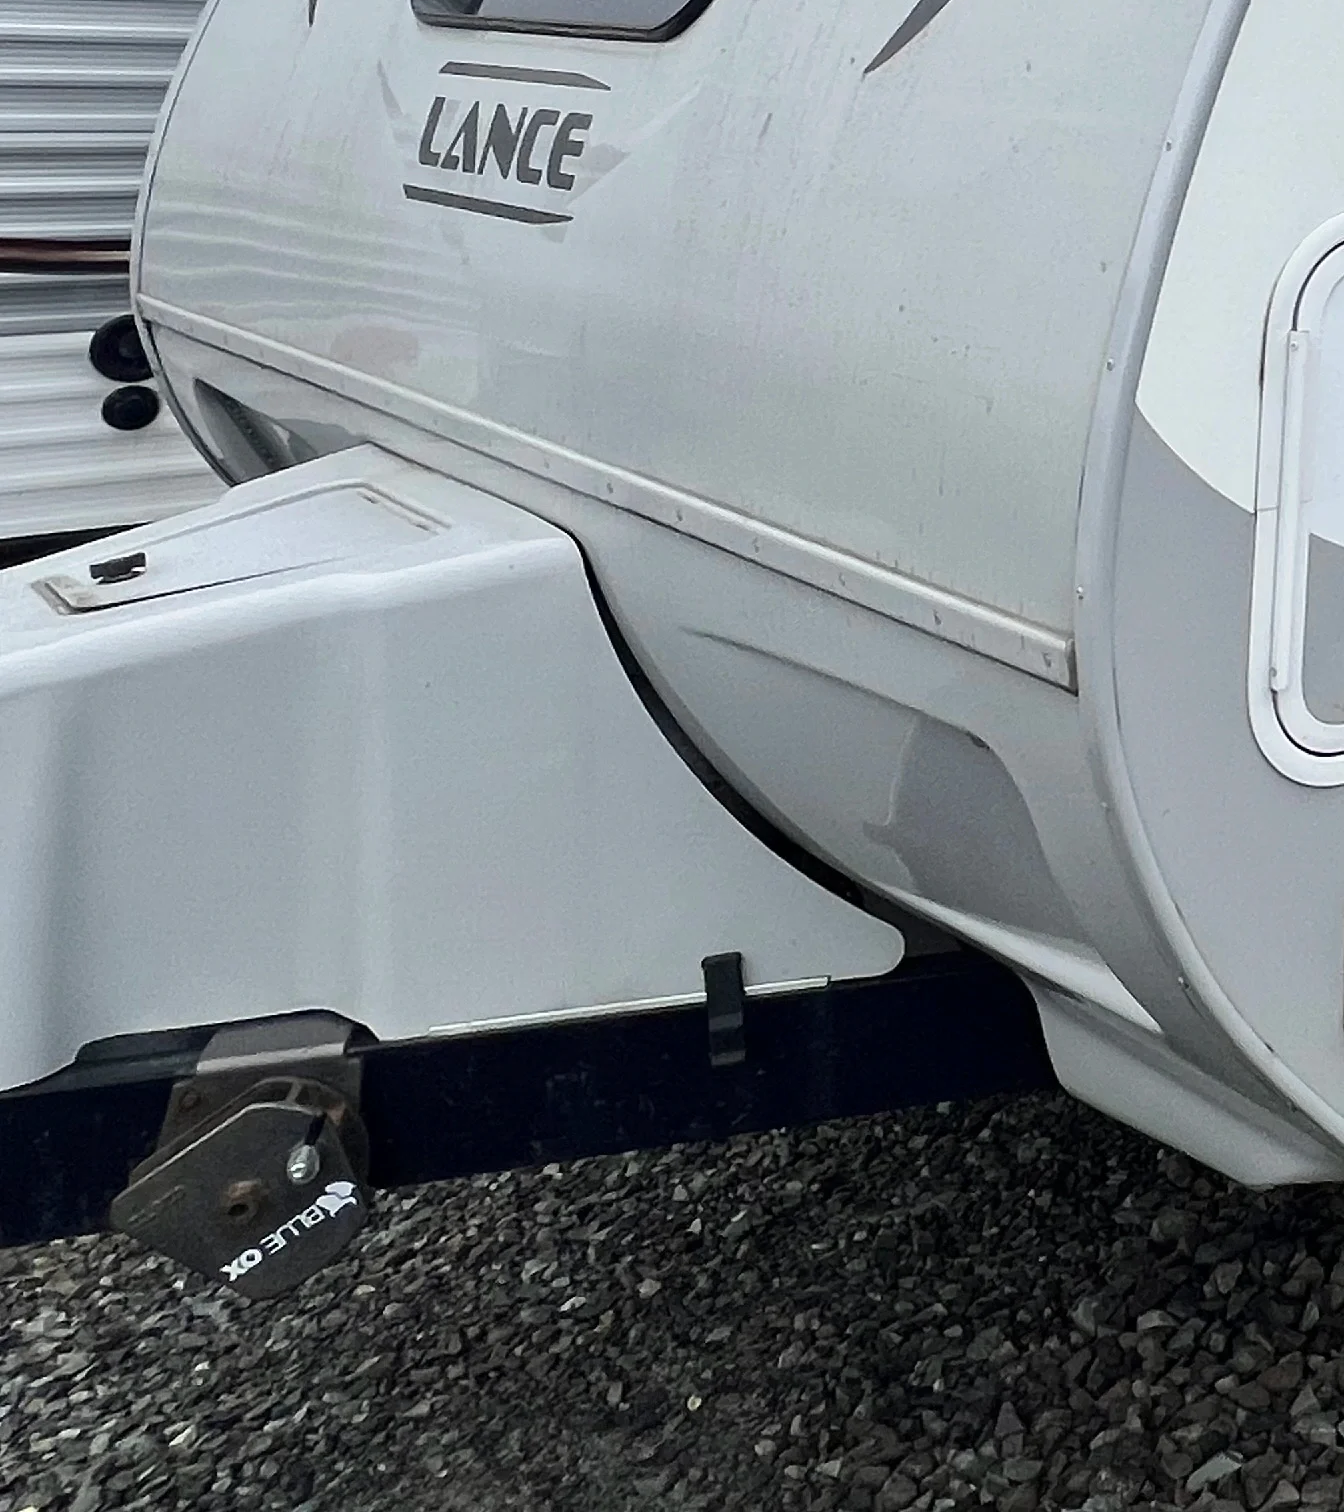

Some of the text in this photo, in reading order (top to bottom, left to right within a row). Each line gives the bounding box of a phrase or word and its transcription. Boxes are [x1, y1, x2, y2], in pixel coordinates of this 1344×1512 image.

[418, 96, 594, 192] LANCE
[219, 1204, 326, 1282] BLUE OX
